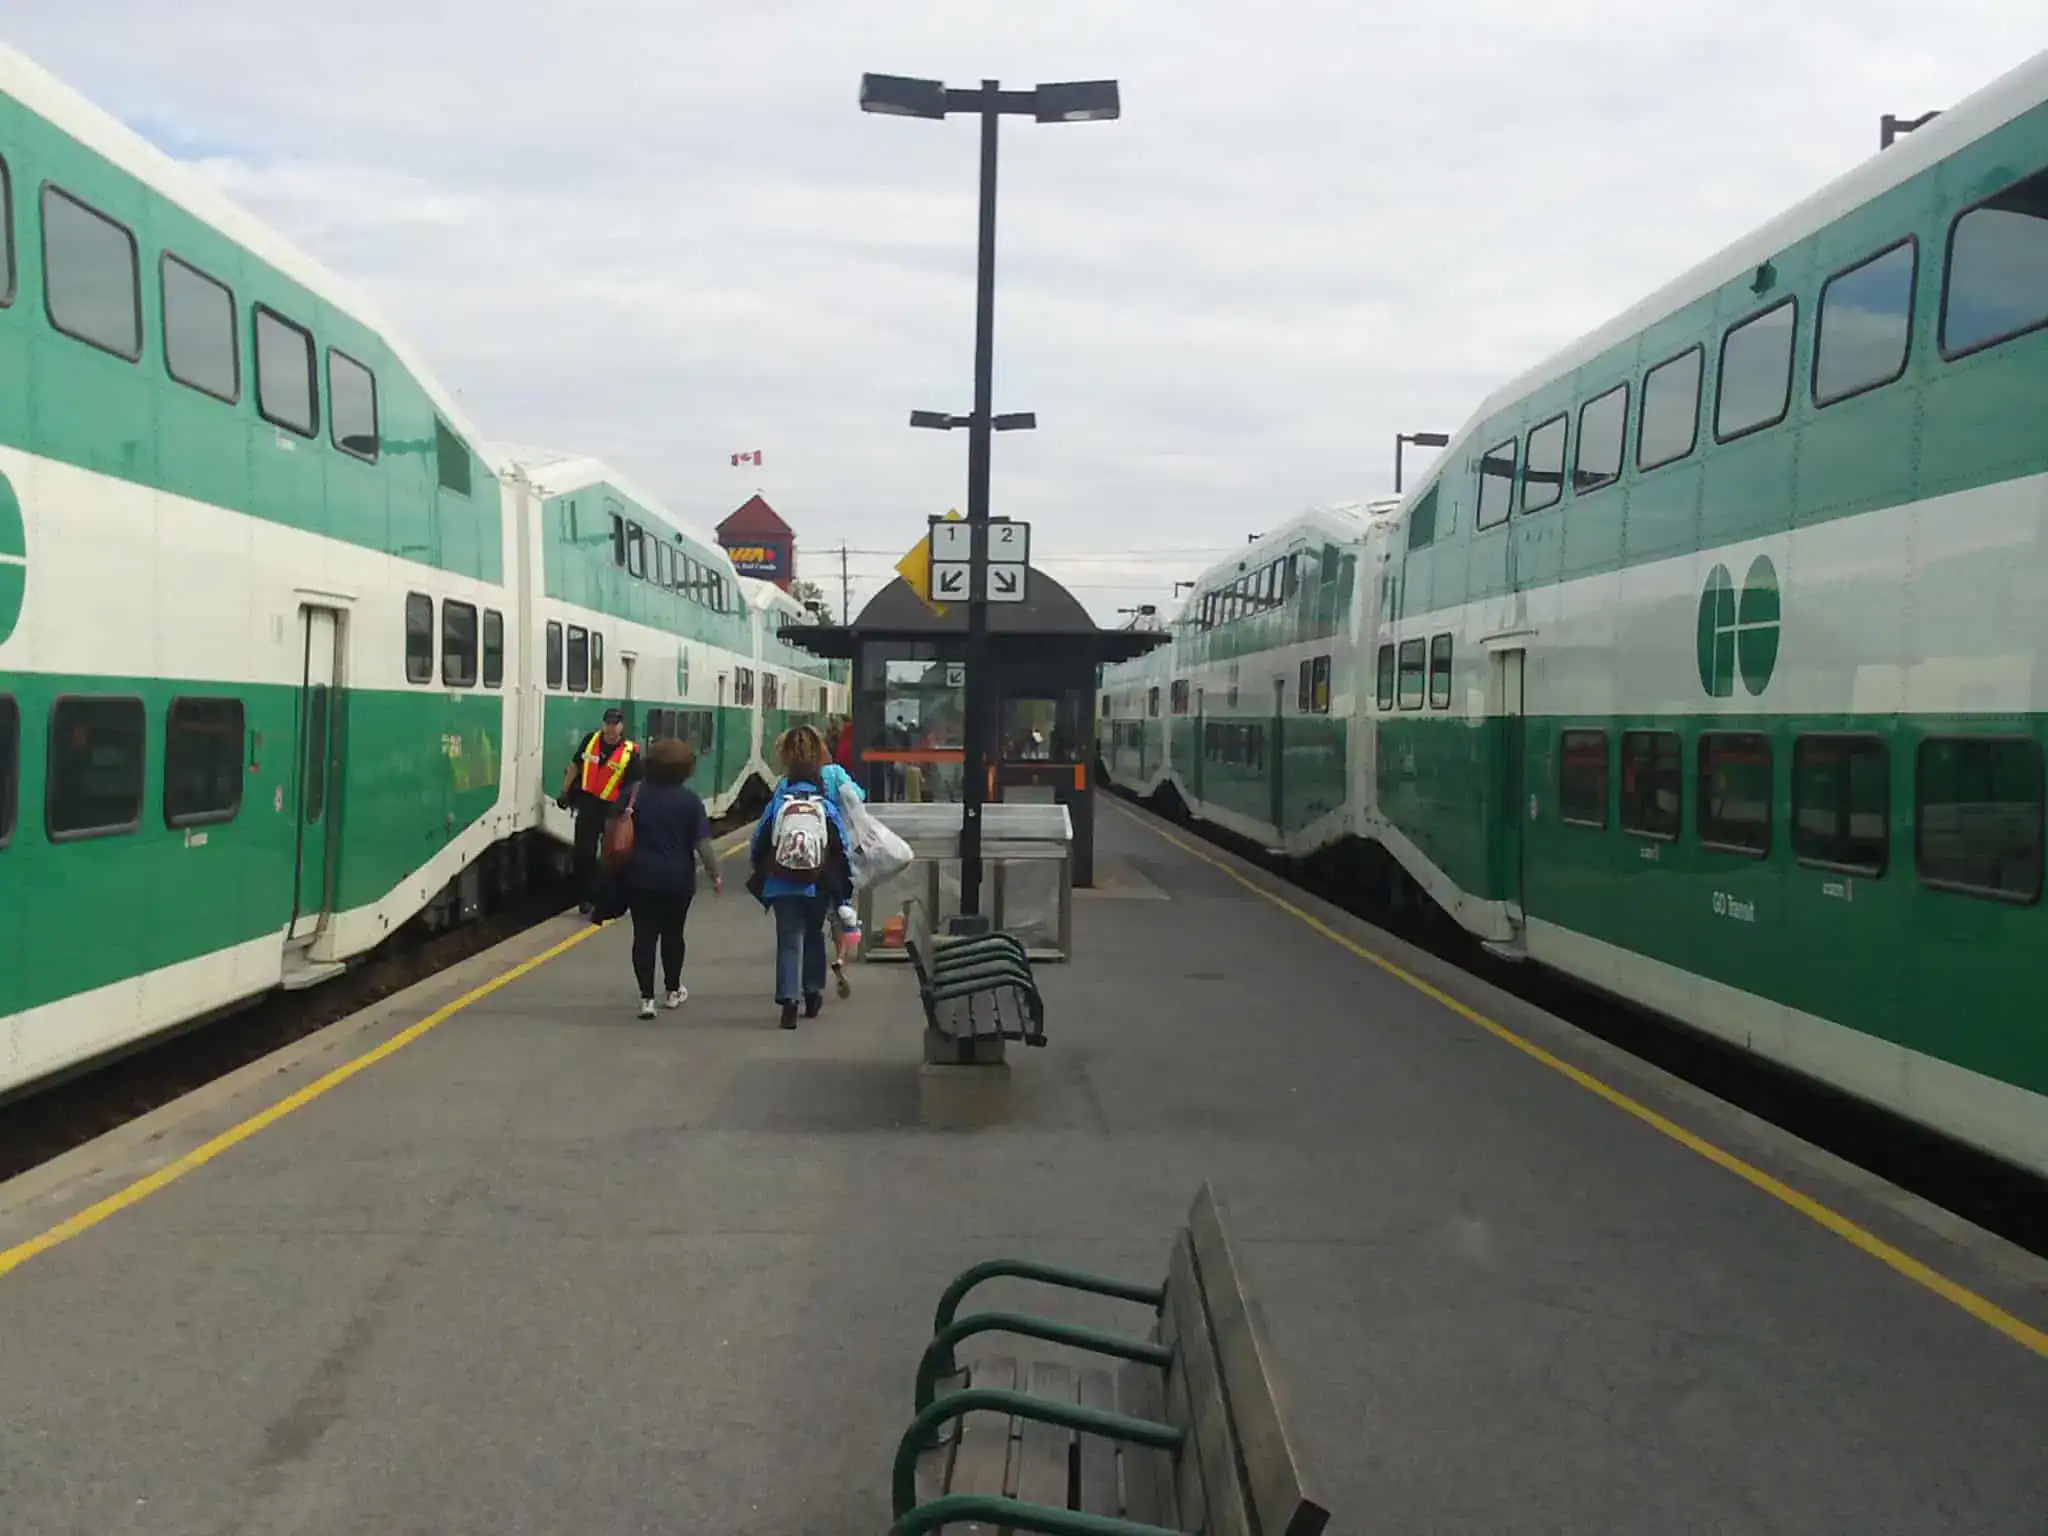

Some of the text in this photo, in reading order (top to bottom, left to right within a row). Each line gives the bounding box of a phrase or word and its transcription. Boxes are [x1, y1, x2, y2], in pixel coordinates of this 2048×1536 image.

[947, 527, 955, 541] 1
[1001, 527, 1013, 542] 2
[1712, 891, 1726, 916] GO
